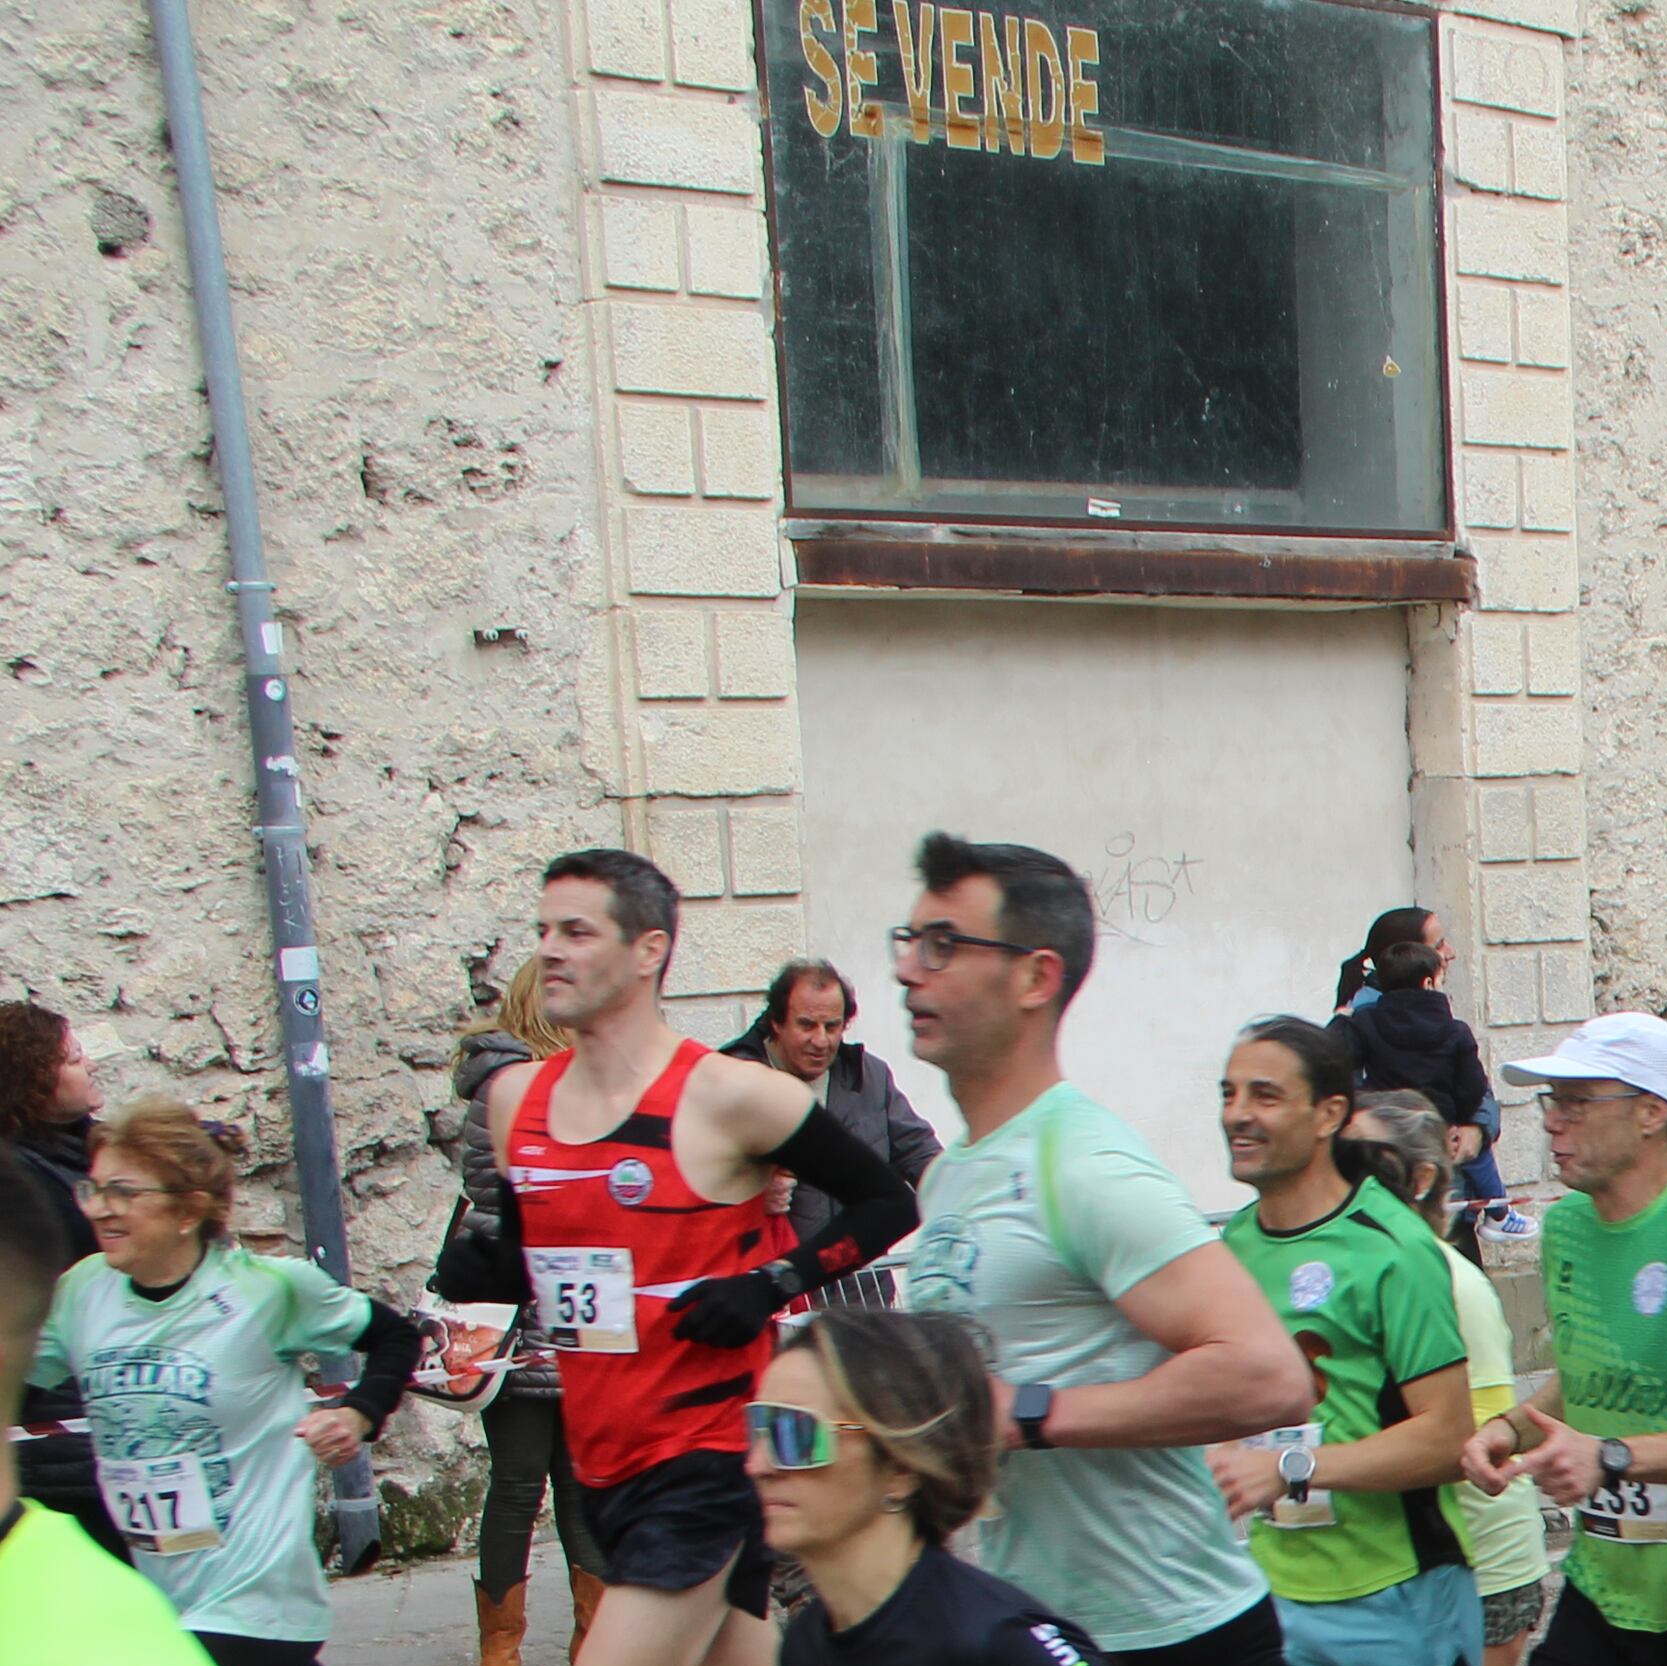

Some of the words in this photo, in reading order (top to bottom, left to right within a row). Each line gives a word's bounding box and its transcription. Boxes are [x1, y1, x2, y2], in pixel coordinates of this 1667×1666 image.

[800, 0, 884, 138] SE
[897, 0, 1105, 166] VENDE
[558, 1282, 598, 1324] 53
[117, 1490, 180, 1530] 217
